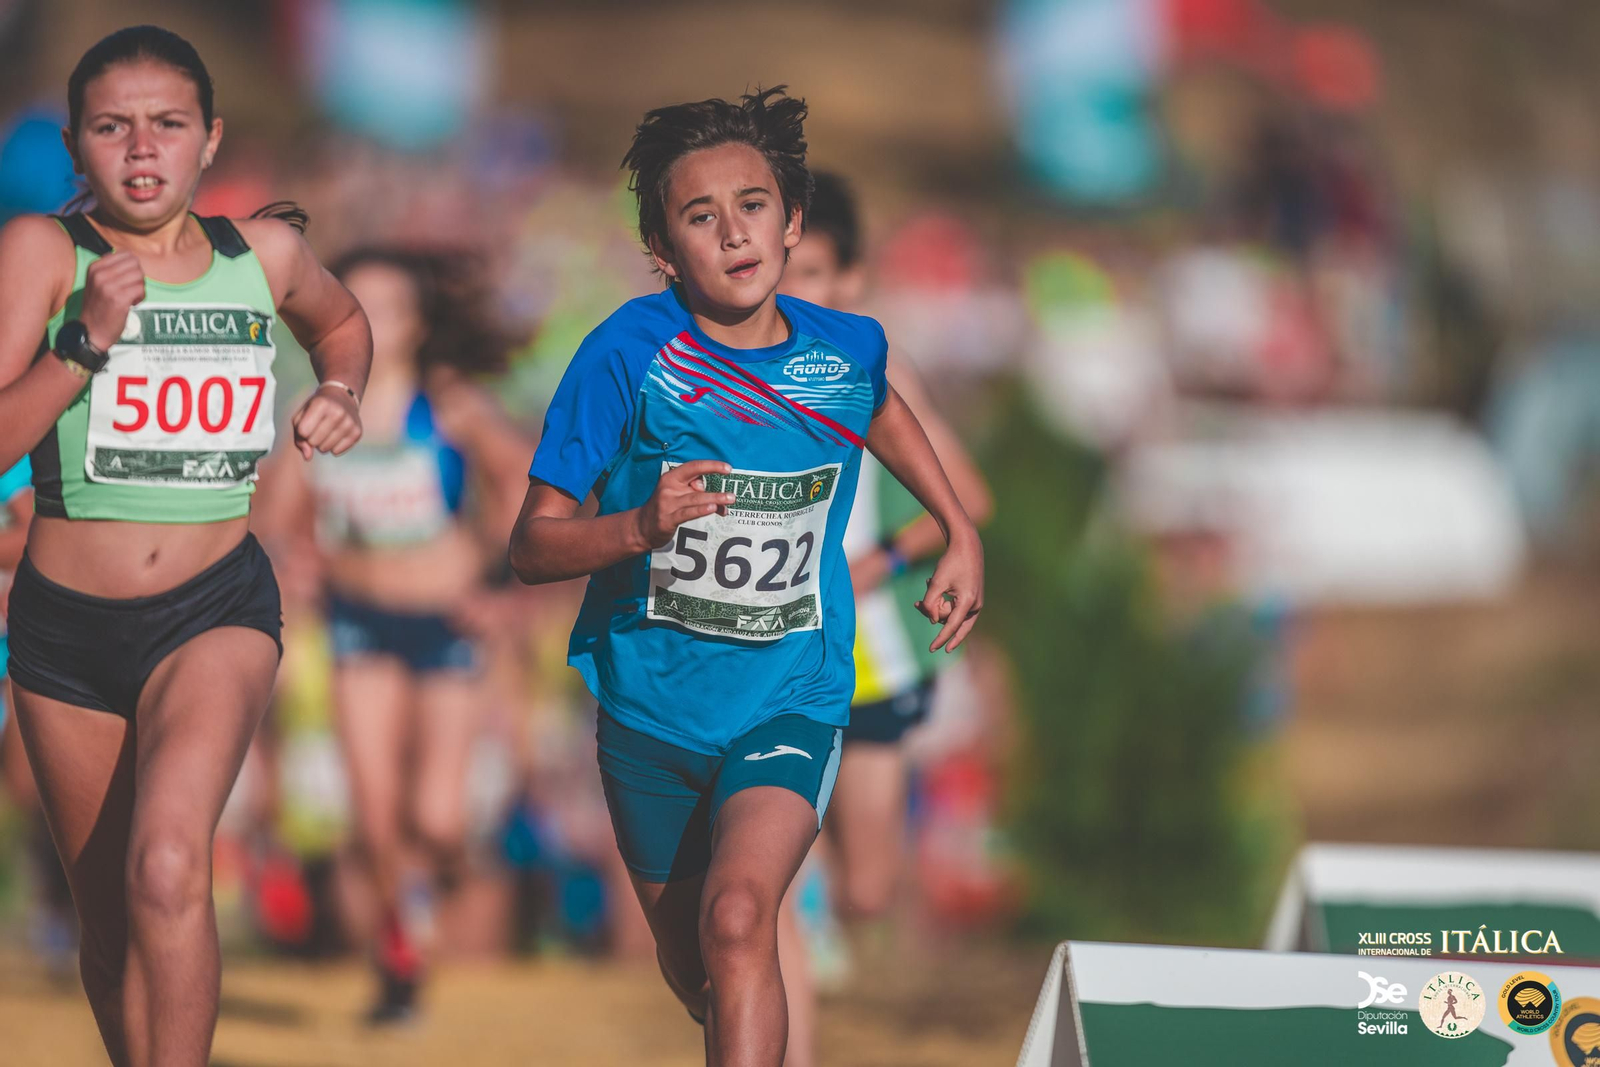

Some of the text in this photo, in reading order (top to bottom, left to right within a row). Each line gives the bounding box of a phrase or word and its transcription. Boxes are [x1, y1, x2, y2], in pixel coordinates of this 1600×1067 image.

[153, 309, 239, 335] ITÁLICA
[783, 363, 851, 376] CRONOS
[112, 375, 266, 434] 5007
[720, 477, 804, 500] ITÁLICA
[726, 505, 815, 520] STERRECHEA RODRIGUEZ
[757, 519, 783, 527] CRONOS
[670, 526, 814, 591] 5622
[736, 614, 786, 631] FAA
[721, 628, 752, 637] ANDALUZA
